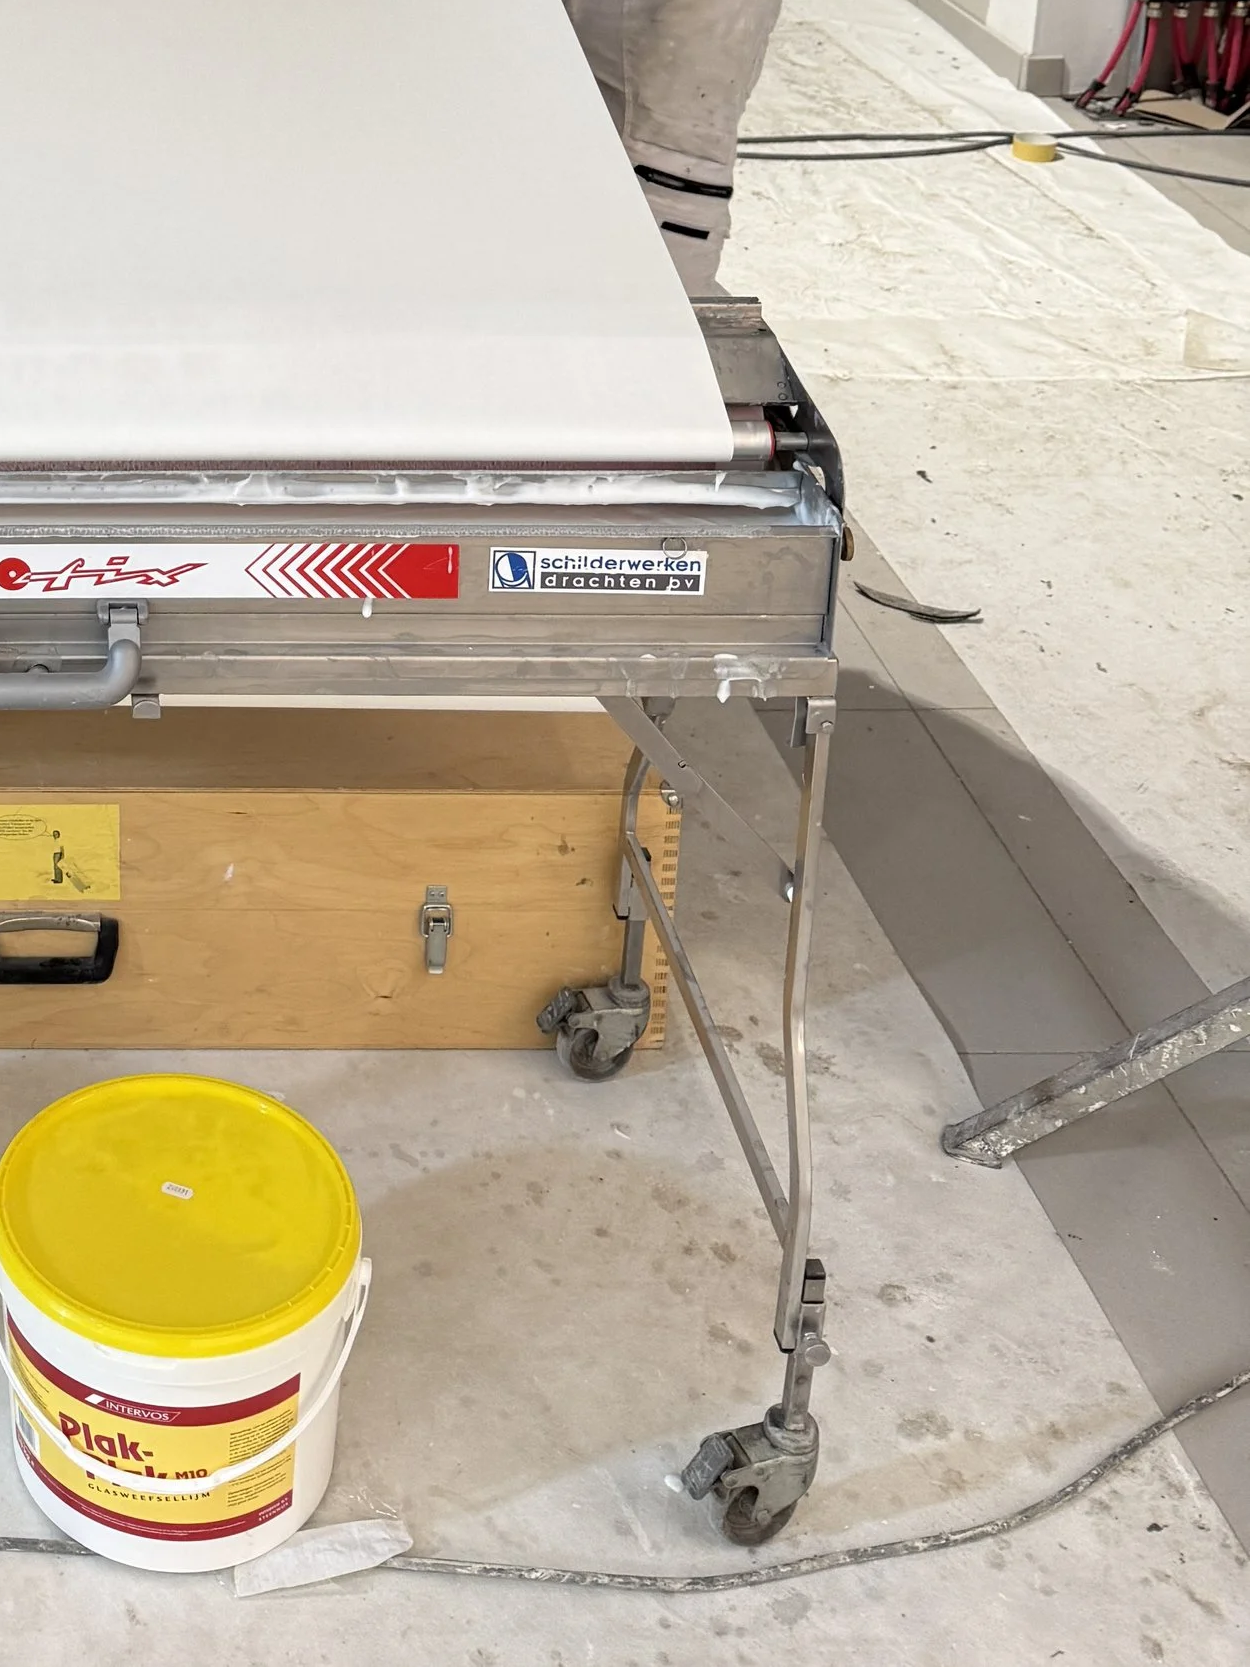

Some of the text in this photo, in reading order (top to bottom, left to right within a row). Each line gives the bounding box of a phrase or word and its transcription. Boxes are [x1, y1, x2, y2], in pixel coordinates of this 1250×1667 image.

[540, 555, 701, 572] schilderwerken
[544, 573, 694, 590] drachten bv
[104, 1400, 170, 1421] INTERVOS
[58, 1411, 154, 1462] Plak-
